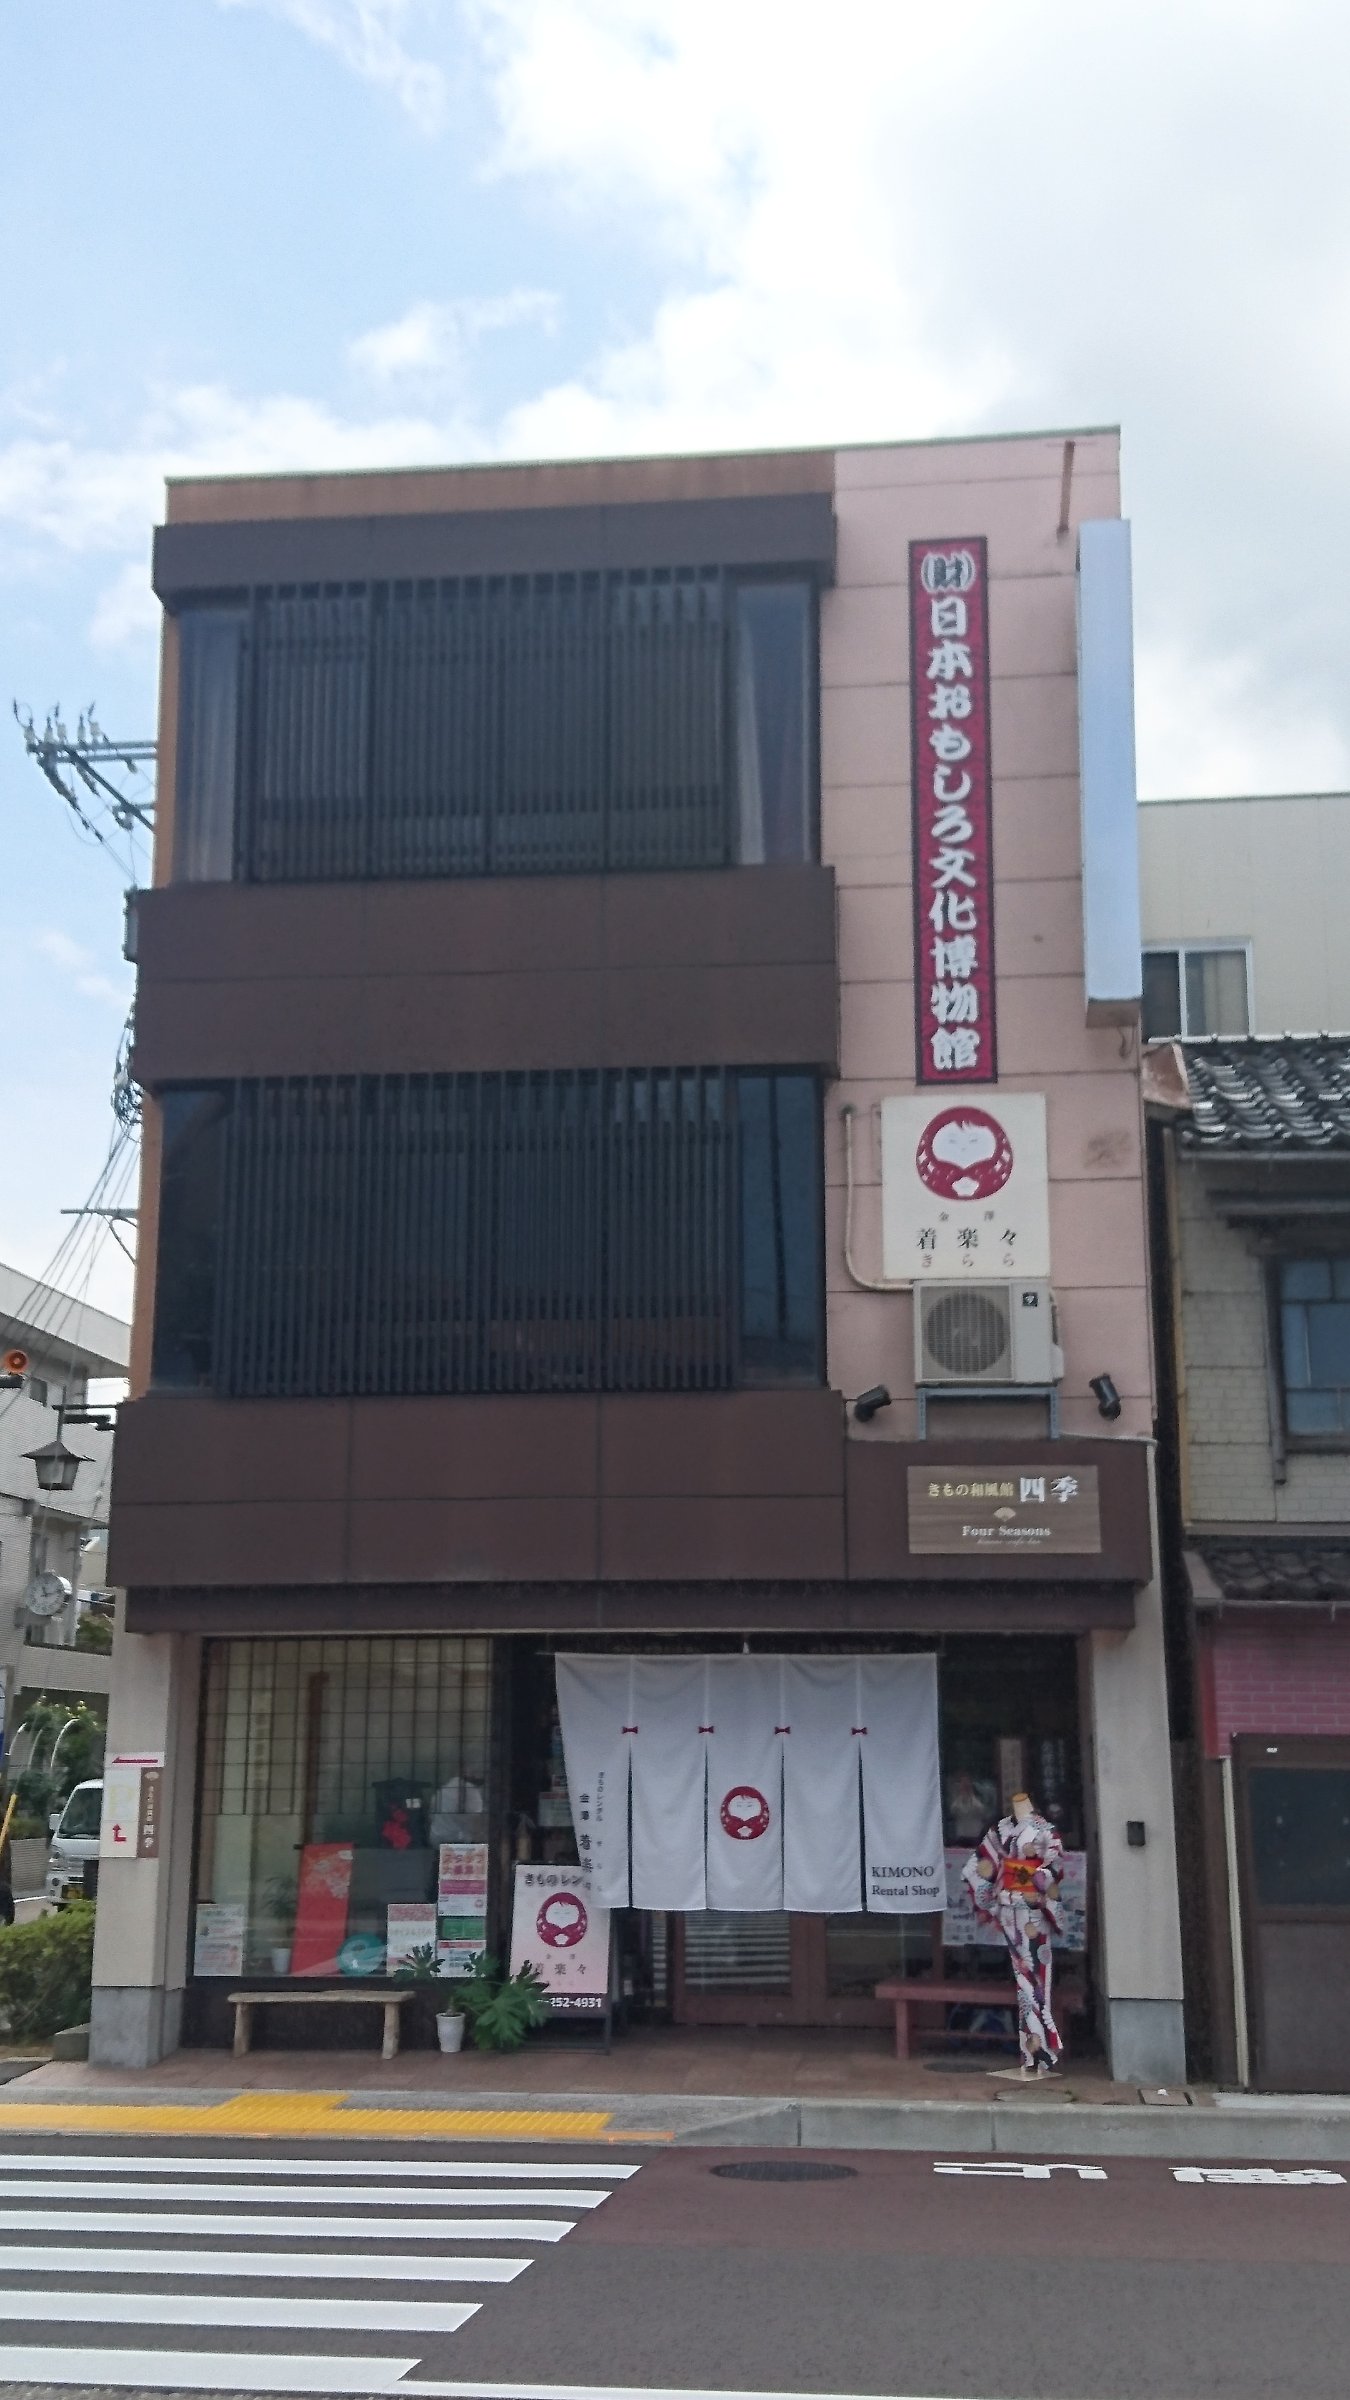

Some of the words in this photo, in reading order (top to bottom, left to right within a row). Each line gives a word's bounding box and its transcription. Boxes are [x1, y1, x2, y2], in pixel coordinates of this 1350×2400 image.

[917, 1227, 1017, 1250] 着楽々
[1020, 1475, 1079, 1502] 四季
[961, 1525, 994, 1536] Four
[999, 1525, 1052, 1536] Seasons
[872, 1866, 935, 1878] KIMONO
[525, 1873, 584, 1887] きものレン
[872, 1885, 909, 1896] Rental
[912, 1886, 940, 1898] Shop
